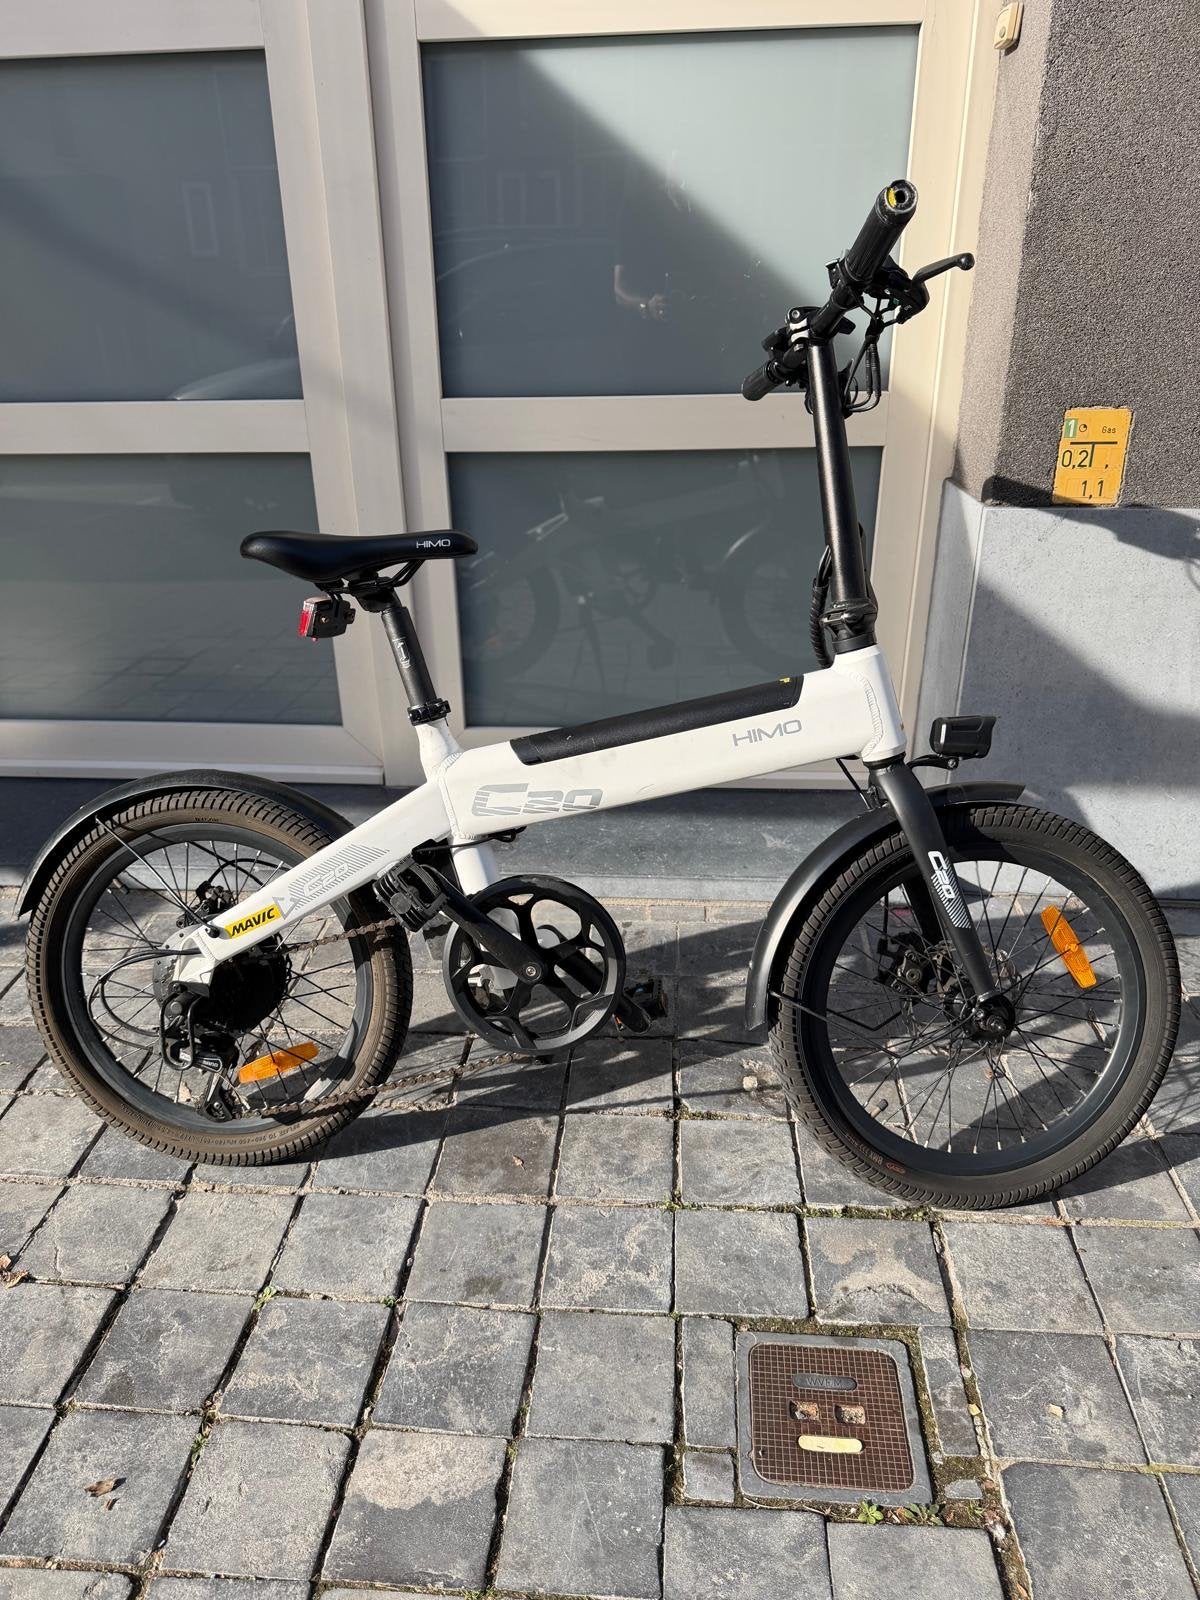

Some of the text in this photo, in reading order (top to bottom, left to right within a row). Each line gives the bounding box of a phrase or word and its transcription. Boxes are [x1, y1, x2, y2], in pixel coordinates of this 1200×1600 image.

[1068, 419, 1076, 438] 1
[1102, 425, 1117, 434] Gas
[1081, 480, 1104, 500] 1,1
[416, 539, 451, 549] HIMO
[732, 719, 803, 748] HIMO
[471, 782, 604, 817] C20
[927, 850, 956, 899] C20
[231, 906, 276, 937] MAVIC
